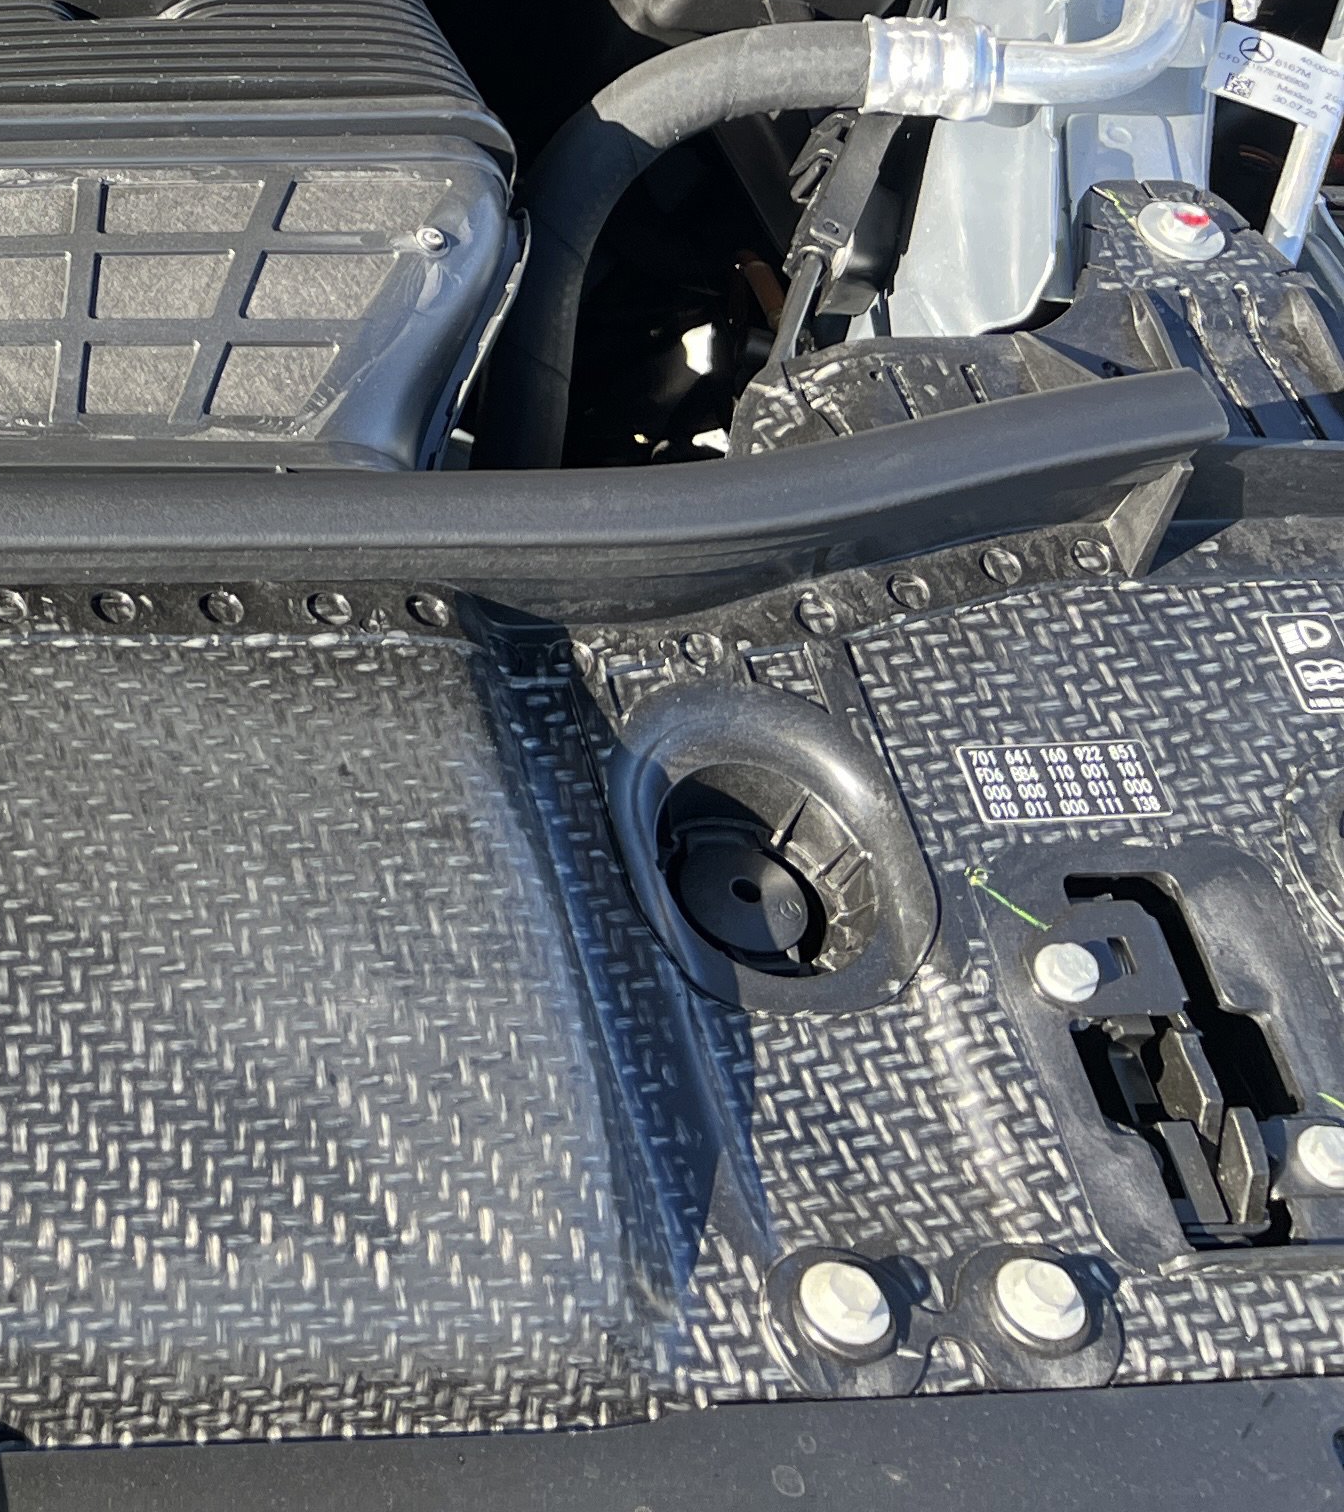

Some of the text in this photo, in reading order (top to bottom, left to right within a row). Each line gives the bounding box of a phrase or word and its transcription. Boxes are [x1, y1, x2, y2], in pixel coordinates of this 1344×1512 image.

[968, 743, 1138, 767] 701 641 160 922 851
[974, 766, 1005, 785] FD6
[1046, 764, 1075, 782] 110
[1080, 762, 1110, 780] 001
[1116, 760, 1145, 778] 101
[982, 777, 1154, 802] 000 000 110 011 000
[989, 794, 1161, 819] 010 011 000 111 138
